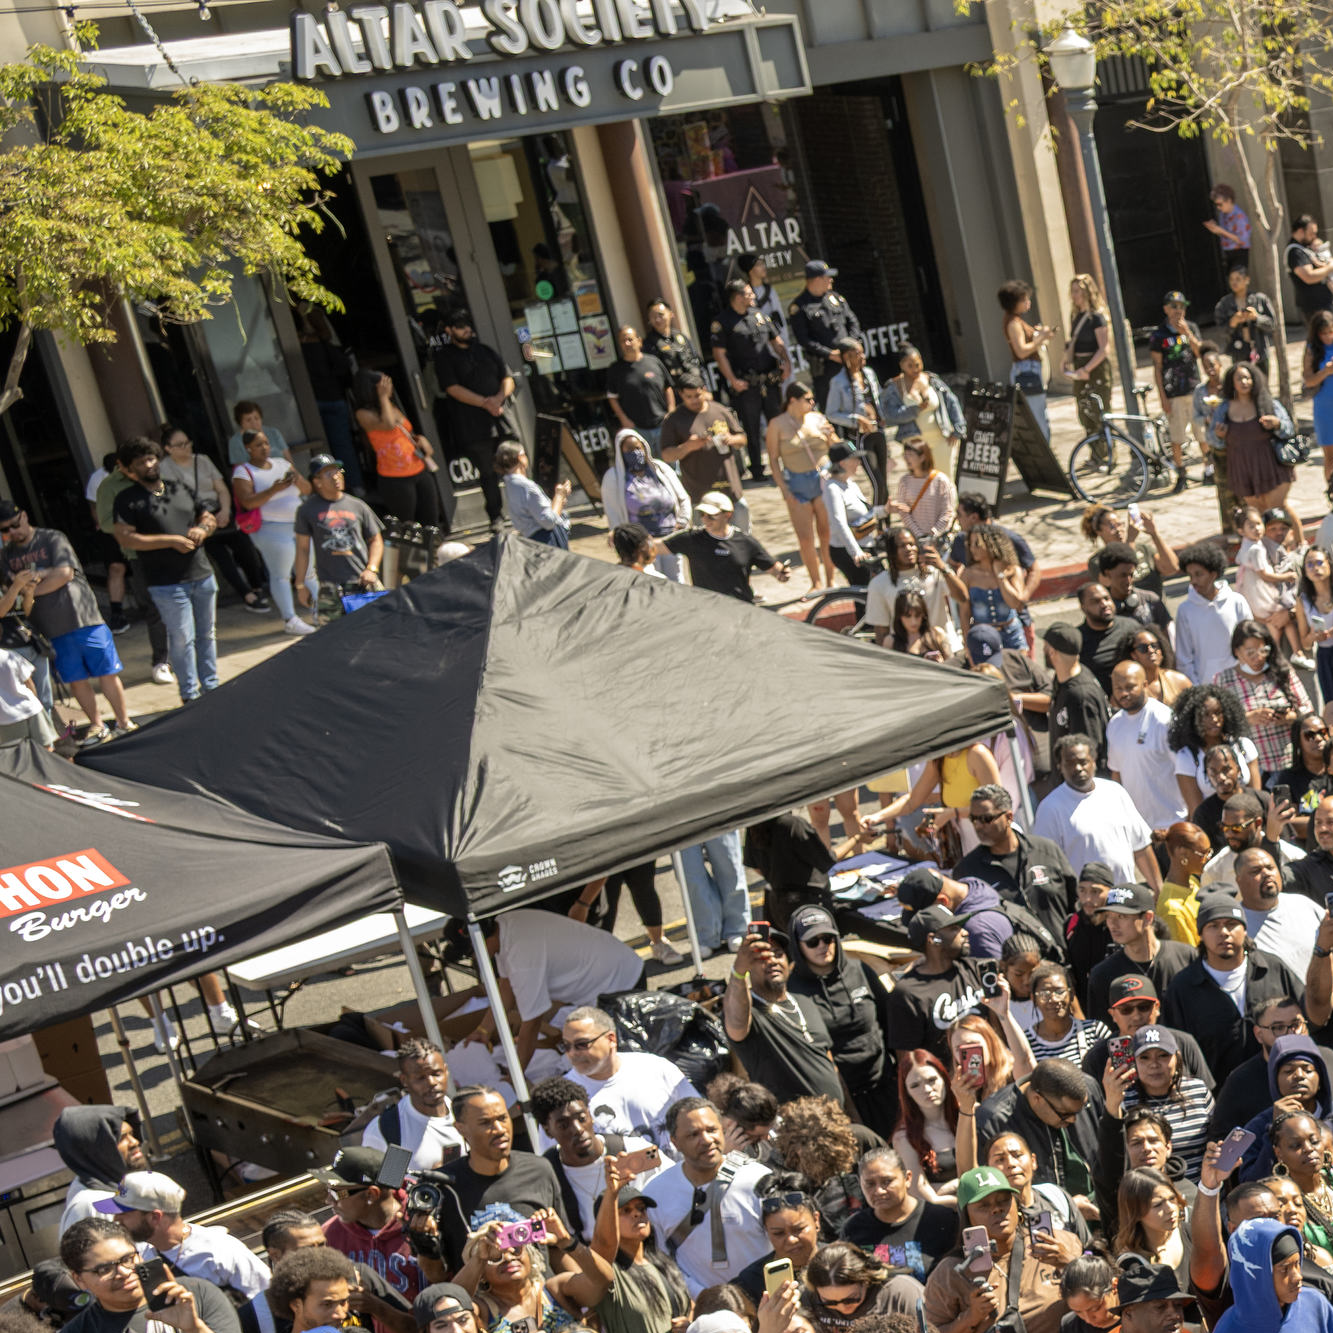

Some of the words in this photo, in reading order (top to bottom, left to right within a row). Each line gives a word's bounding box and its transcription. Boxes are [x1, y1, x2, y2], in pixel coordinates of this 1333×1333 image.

[294, 1, 473, 80] ALTAR
[371, 65, 592, 134] BREWING
[619, 54, 674, 101] CO
[727, 217, 802, 256] ALTAR
[861, 322, 910, 358] OFFEE
[575, 425, 613, 454] EER
[964, 441, 1001, 464] BEER
[528, 857, 557, 874] CROWN
[531, 867, 559, 882] SHADES
[9, 885, 148, 943] Burger
[0, 962, 64, 1014] ou'll
[75, 936, 174, 985] double
[183, 924, 226, 954] up.
[1144, 1029, 1161, 1043] NY
[974, 1172, 1000, 1188] LA
